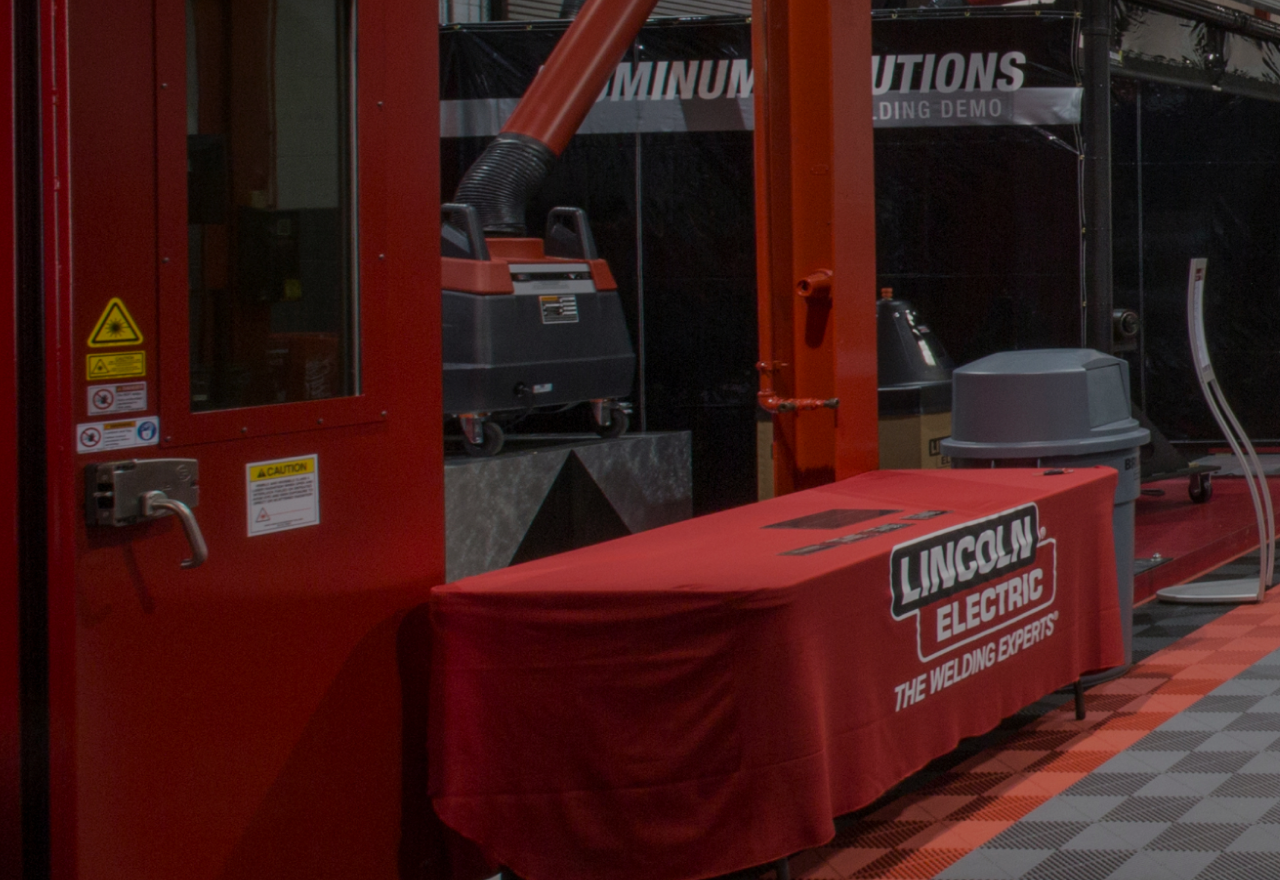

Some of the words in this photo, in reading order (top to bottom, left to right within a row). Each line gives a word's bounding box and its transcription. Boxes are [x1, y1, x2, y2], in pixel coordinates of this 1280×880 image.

[597, 59, 755, 102] MINUM
[872, 51, 1026, 95] UTIONS
[872, 101, 930, 120] DING
[941, 98, 1001, 118] DEMO
[267, 462, 307, 477] CAUTION
[901, 515, 1033, 605] LINCOLN
[937, 568, 1044, 643] ELECTRIC
[894, 673, 928, 713] THE
[929, 642, 996, 695] WELDING
